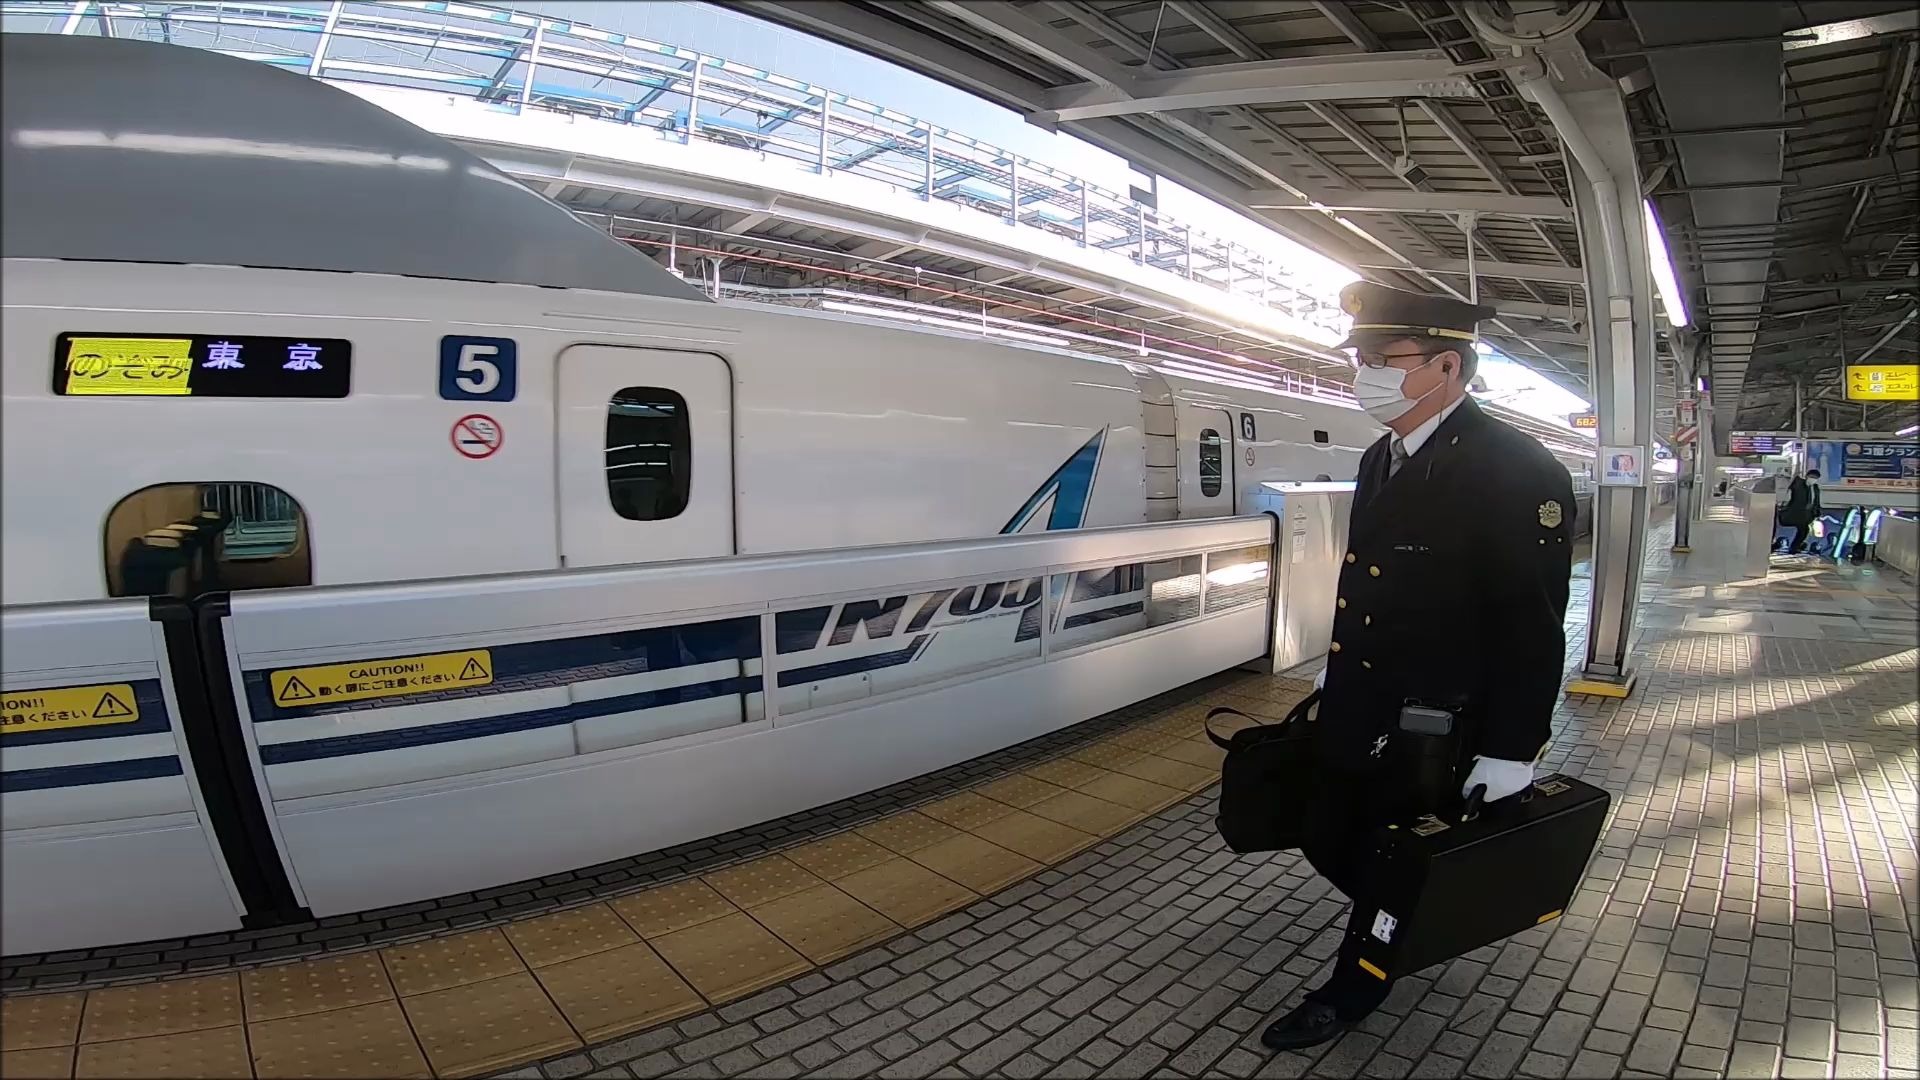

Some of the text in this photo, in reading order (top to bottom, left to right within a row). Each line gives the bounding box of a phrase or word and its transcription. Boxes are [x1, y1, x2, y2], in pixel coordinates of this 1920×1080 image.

[455, 345, 501, 394] 5
[1243, 416, 1253, 439] 6
[349, 663, 425, 679] CAUTION!!
